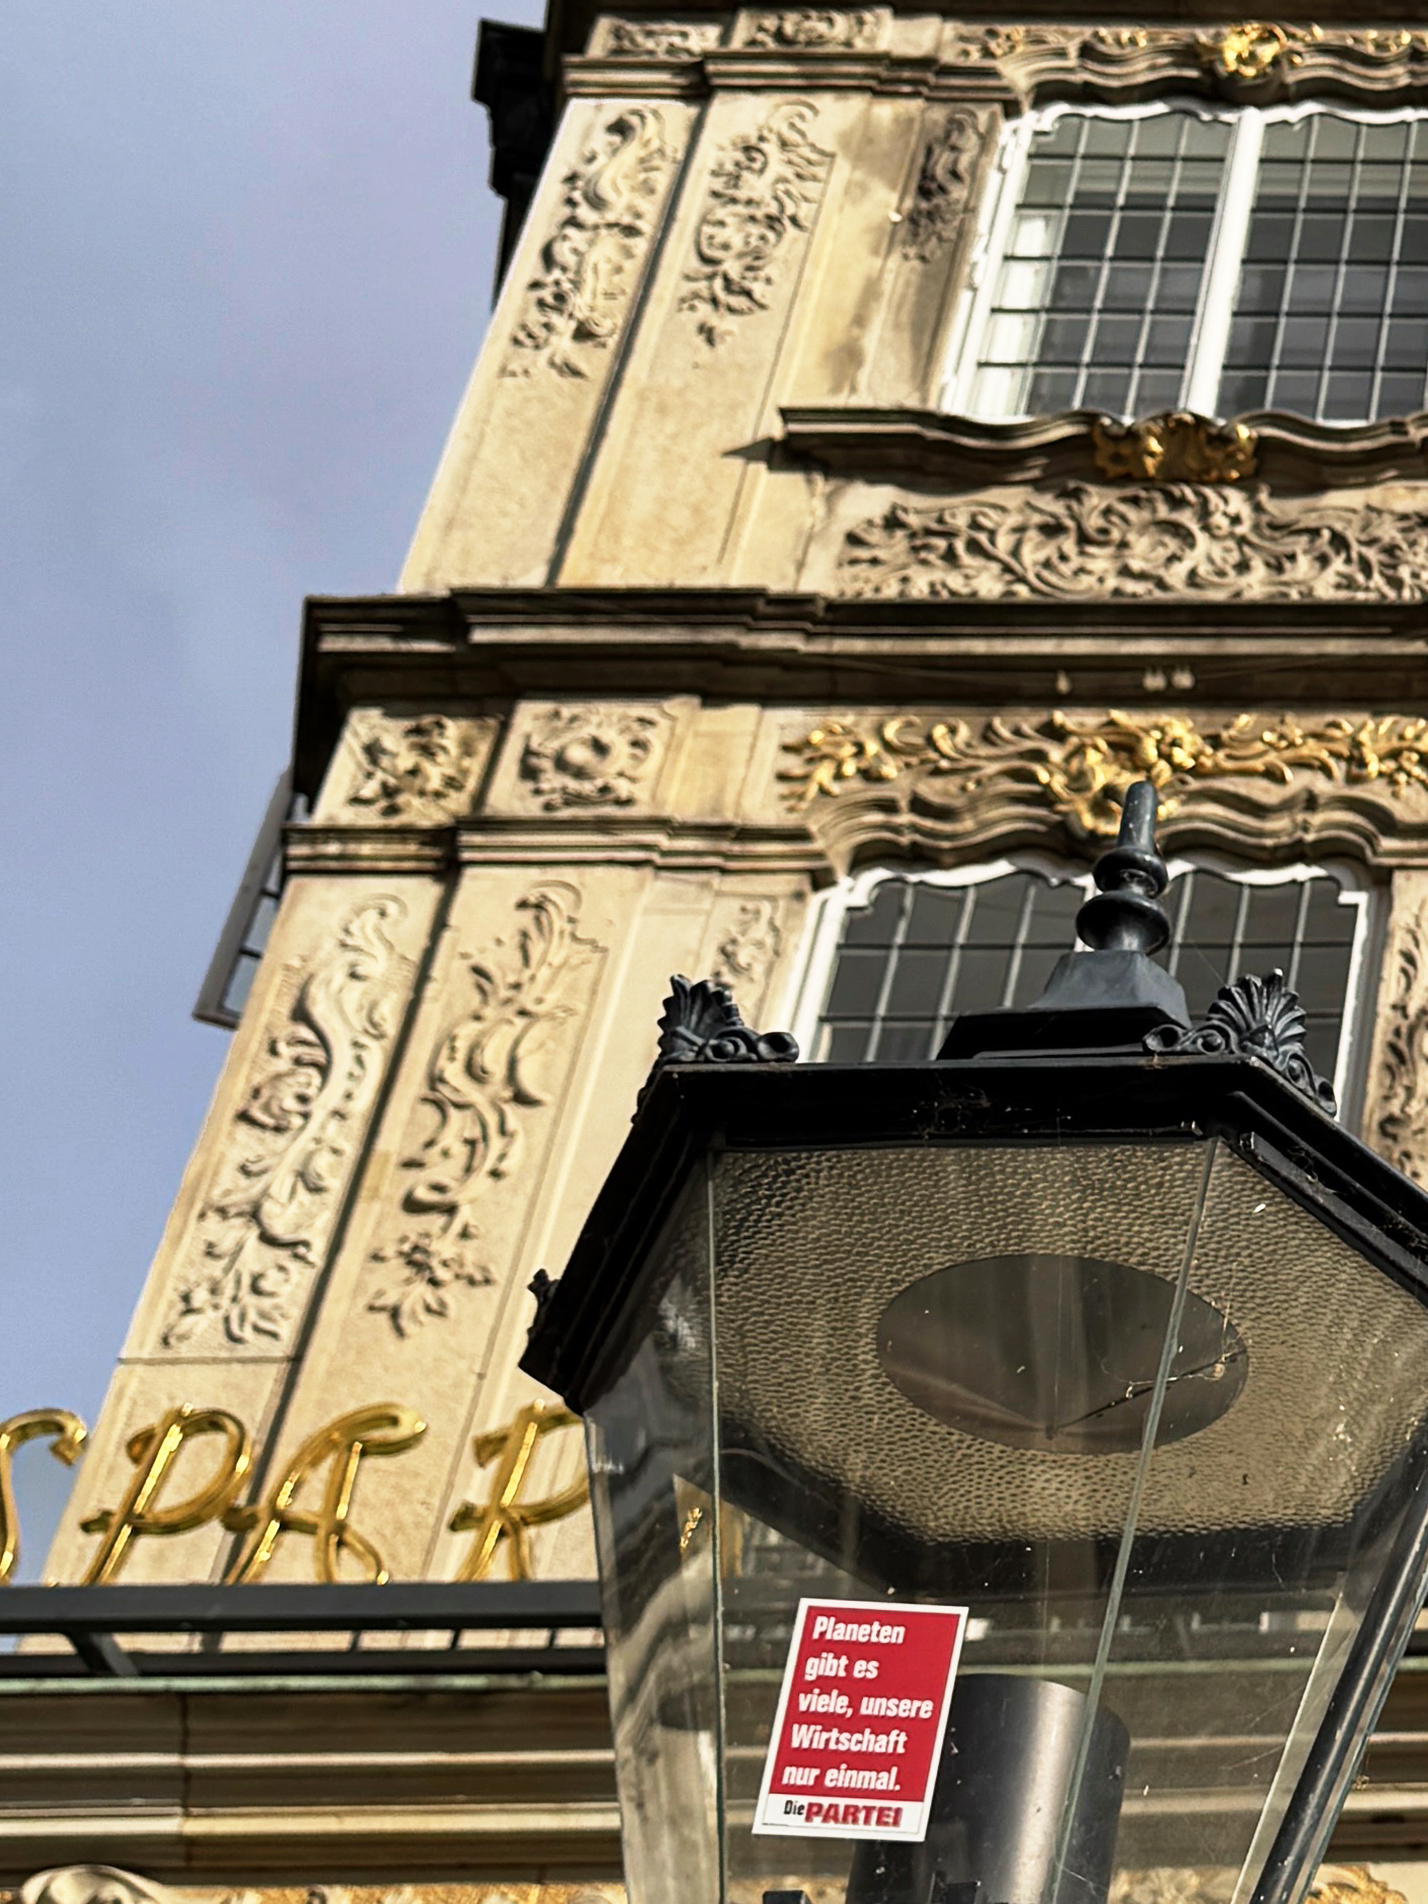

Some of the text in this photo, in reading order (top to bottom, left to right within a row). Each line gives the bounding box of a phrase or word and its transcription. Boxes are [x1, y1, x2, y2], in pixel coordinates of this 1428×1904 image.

[812, 1615, 906, 1644] Planeten
[804, 1652, 880, 1681] gibt es
[799, 1688, 934, 1718] viele, unsere
[791, 1723, 908, 1754] Wirtschaft
[782, 1763, 901, 1791] nur einmal.
[784, 1800, 903, 1828] Die PARTEI
